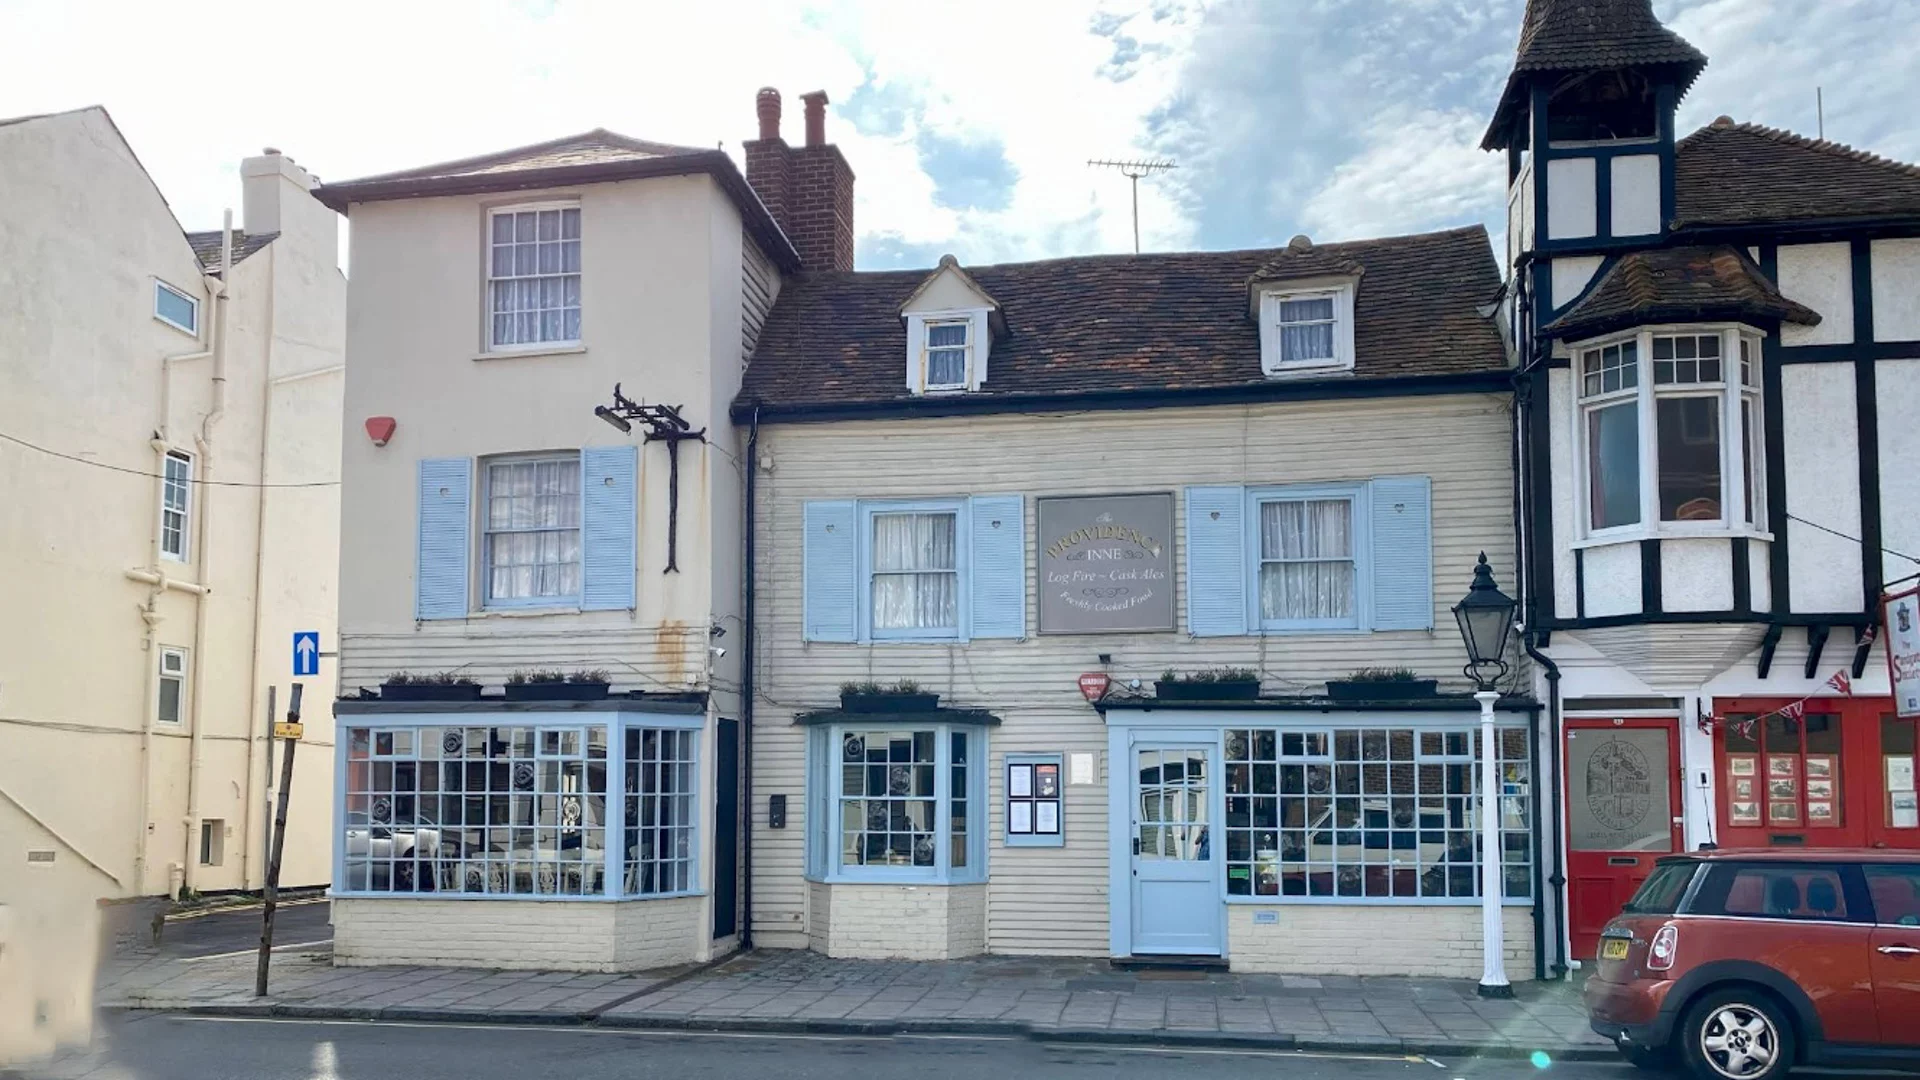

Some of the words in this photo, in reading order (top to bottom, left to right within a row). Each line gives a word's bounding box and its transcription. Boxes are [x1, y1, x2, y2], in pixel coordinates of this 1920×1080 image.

[1087, 548, 1122, 561] INNE
[1047, 571, 1069, 585] Log
[1072, 570, 1097, 582] Fire
[1109, 569, 1138, 581] Cask
[1139, 568, 1165, 580] Ales
[1060, 591, 1093, 611] Freshly
[1095, 600, 1129, 612] Cooked
[1131, 589, 1153, 606] Food
